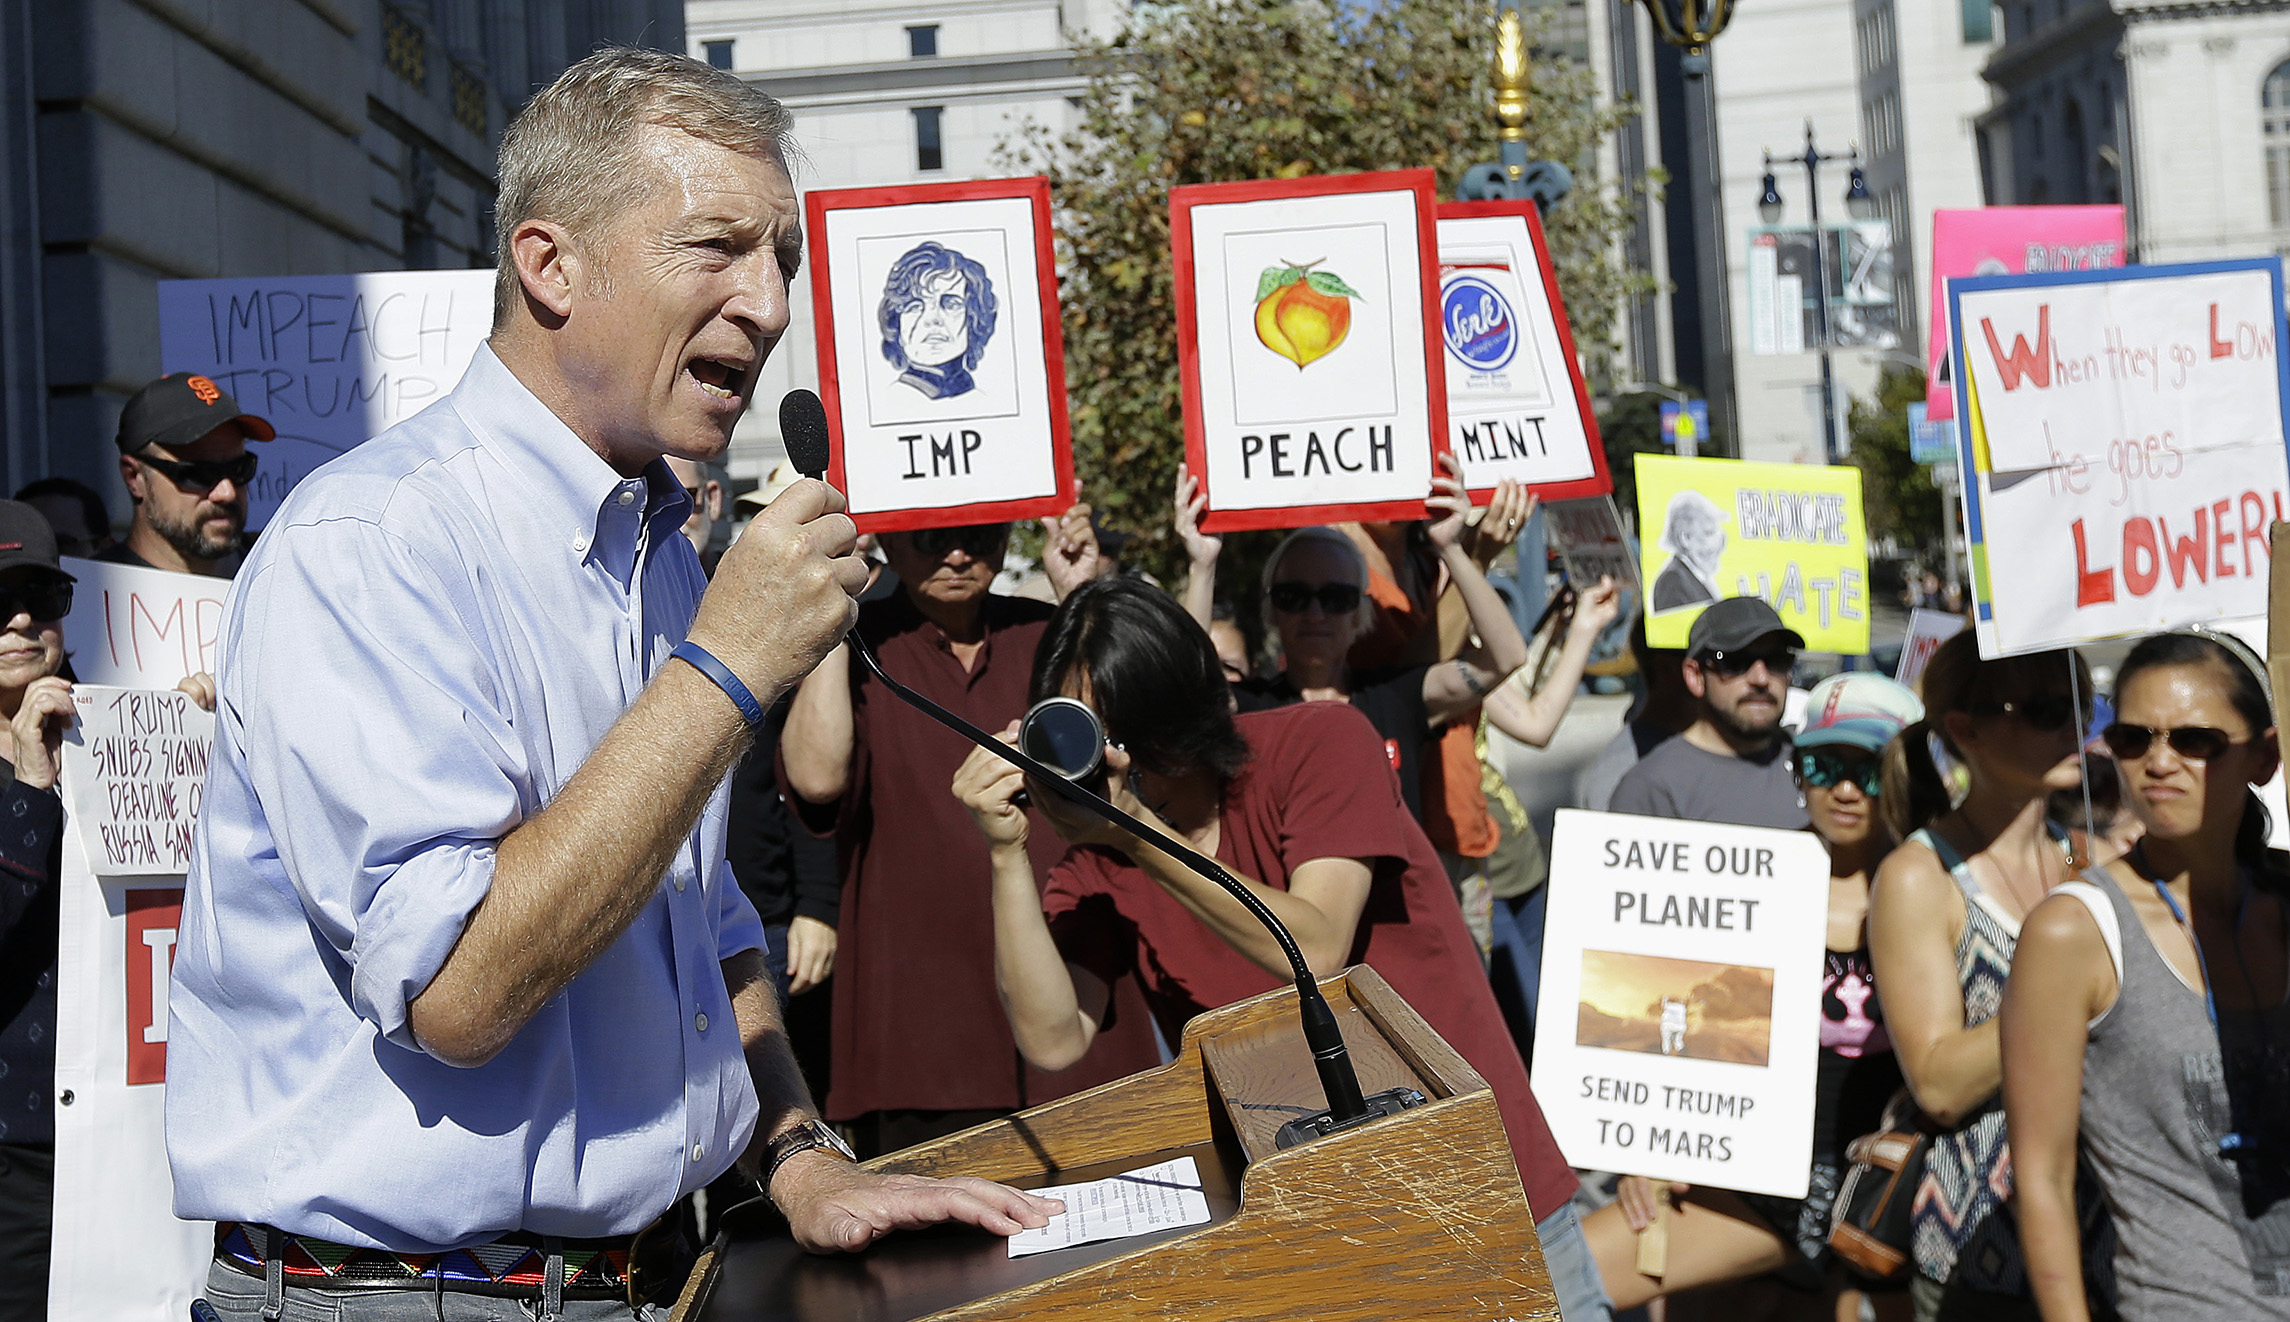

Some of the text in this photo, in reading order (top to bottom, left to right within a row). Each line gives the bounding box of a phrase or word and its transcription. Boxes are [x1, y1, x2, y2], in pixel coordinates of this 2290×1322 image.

[208, 289, 454, 365] IMPEACH
[1981, 303, 2100, 392] When
[2104, 326, 2158, 392] they
[2169, 343, 2197, 389] go
[213, 368, 438, 420] TRUMP
[899, 430, 982, 480] IMP
[1241, 423, 1395, 479] PEACH
[1461, 417, 1547, 465] MINT
[2042, 420, 2184, 507] he goes
[1737, 489, 1849, 545] ERADICATE
[109, 692, 186, 736] TRUMP
[92, 735, 212, 782] SNUBS SIGNIN
[107, 780, 204, 822] DEADLINE O
[99, 820, 197, 868] RUSSIA SAN
[1603, 838, 1774, 878] SAVE OUR
[1614, 891, 1759, 932] PLANET
[1581, 1075, 1755, 1120] SEND TRUMP
[1597, 1118, 1732, 1162] TO MARS
